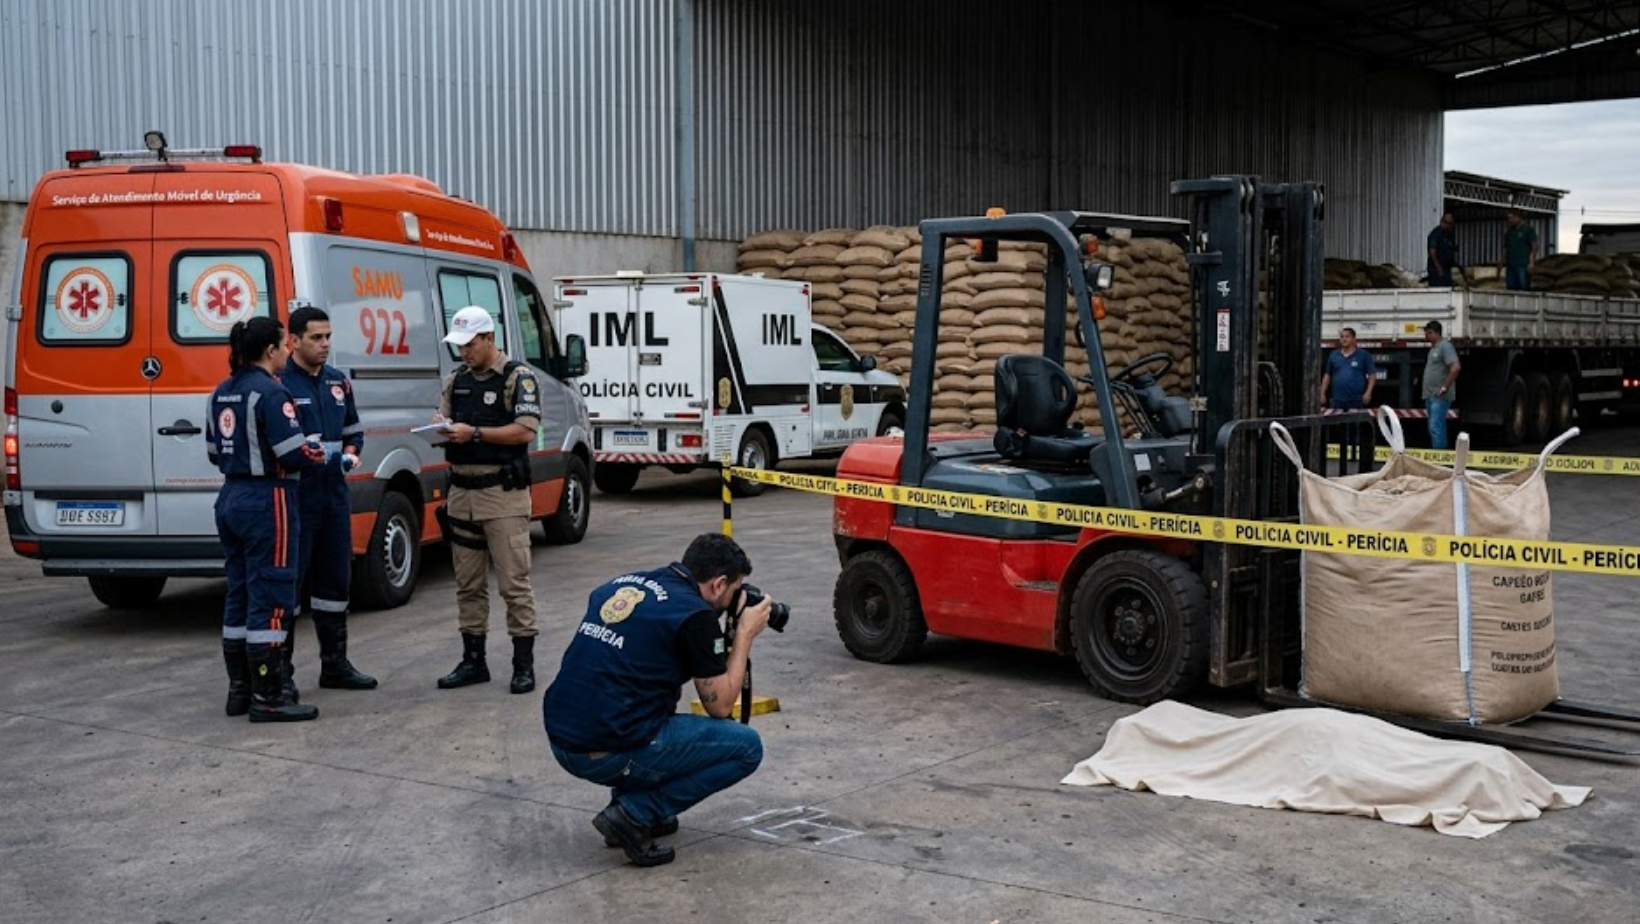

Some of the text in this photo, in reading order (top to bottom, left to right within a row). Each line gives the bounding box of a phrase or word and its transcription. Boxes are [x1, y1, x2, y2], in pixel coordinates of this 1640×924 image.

[88, 193, 100, 203] de
[167, 189, 199, 201] Móvel
[200, 189, 214, 200] de
[351, 265, 403, 300] SAMU
[360, 307, 409, 355] 922
[590, 311, 669, 346] IML
[762, 313, 802, 346] IML
[579, 378, 694, 398] OLÍCIA CIVIL
[949, 495, 976, 510] CIVIL
[1106, 513, 1139, 529] CIVIL
[1150, 515, 1203, 535] PERÍCIA
[1236, 524, 1292, 543] POLÍCIA
[1295, 529, 1334, 547] CIVIL
[1347, 532, 1409, 553] PERÍCIA
[1449, 539, 1517, 561] POLÍCIA
[1521, 546, 1567, 565] CIVIL
